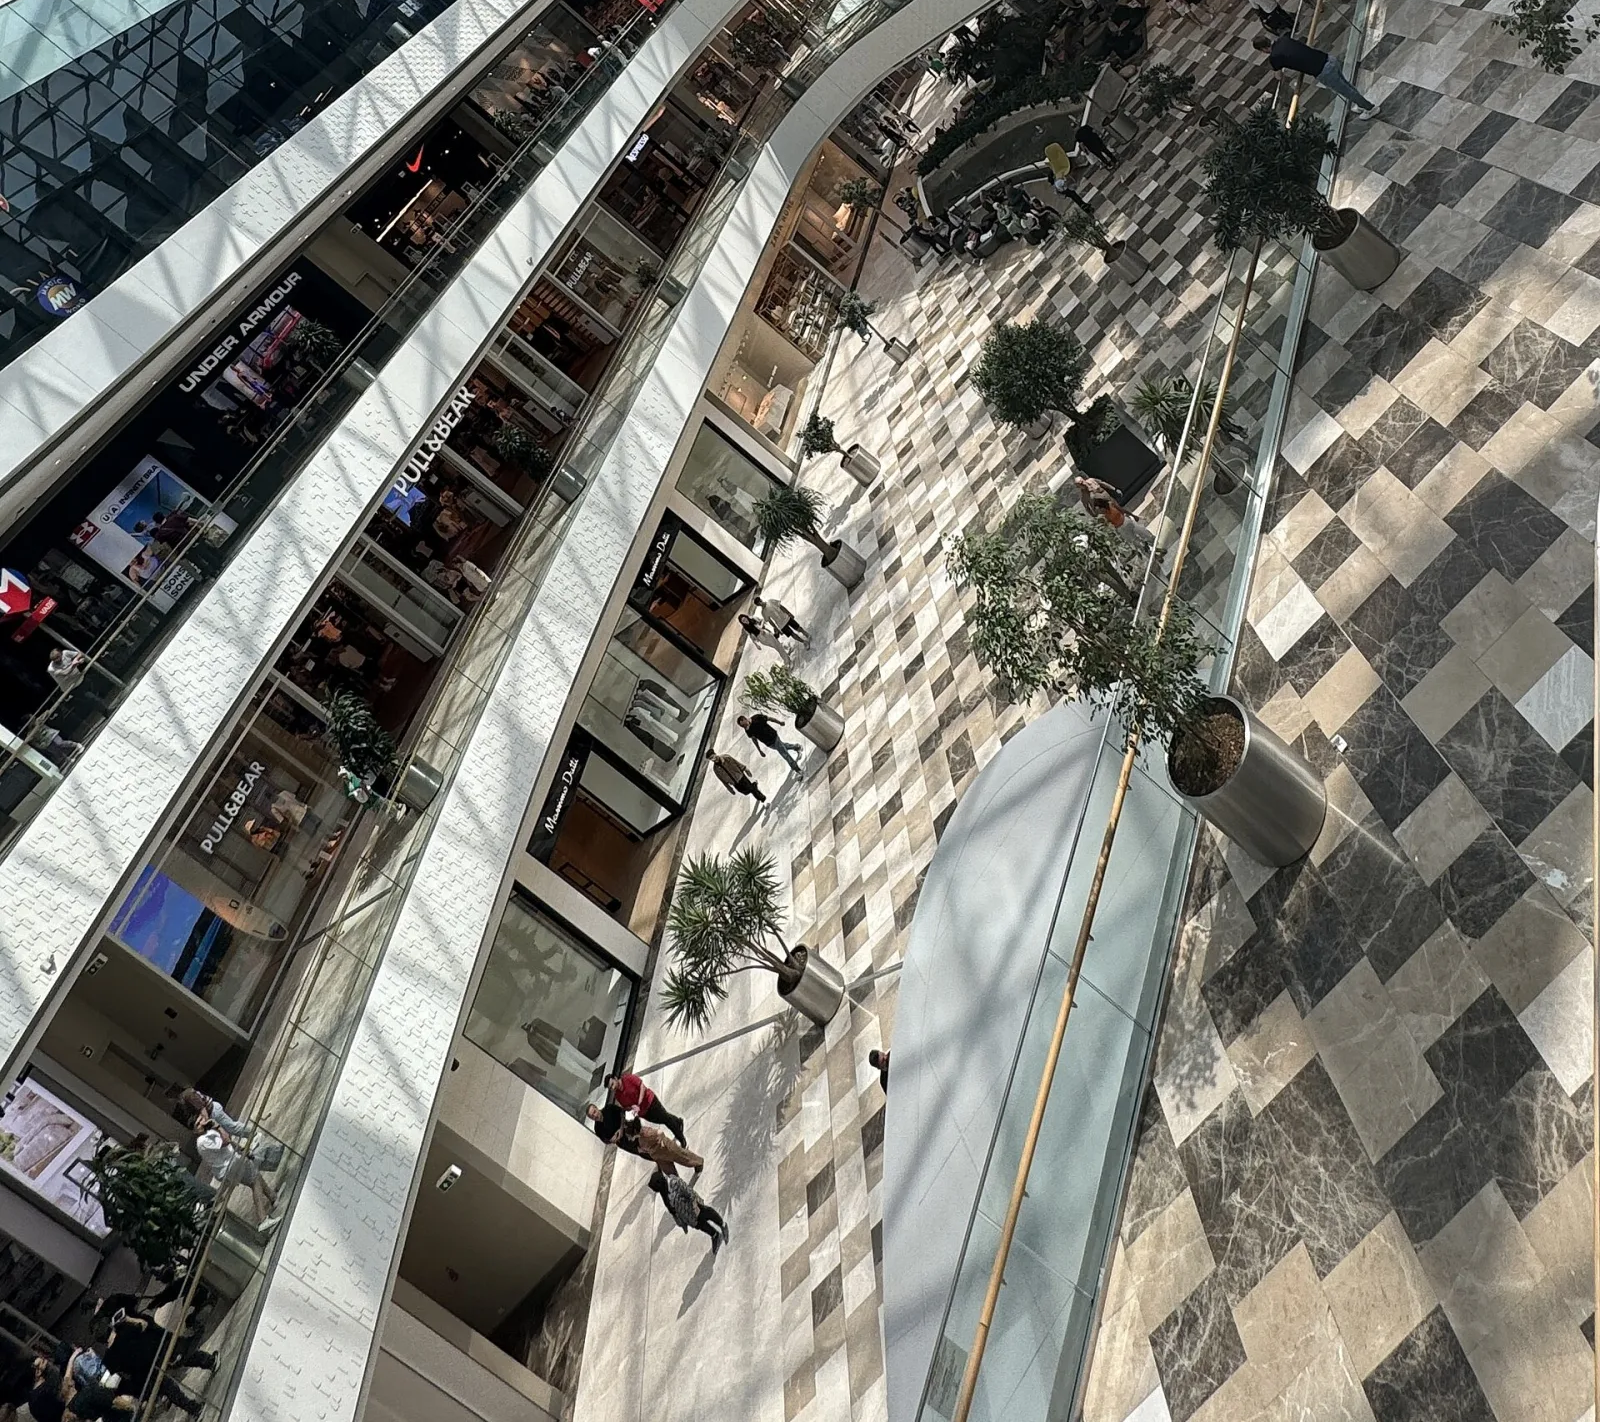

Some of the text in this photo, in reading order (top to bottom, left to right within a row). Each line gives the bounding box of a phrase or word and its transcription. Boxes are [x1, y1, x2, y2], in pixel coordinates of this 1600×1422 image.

[625, 133, 650, 162] NESPRESSO
[49, 283, 77, 311] MW
[566, 251, 594, 290] PULL&BEAR
[178, 271, 302, 393] UNDER ARMOUR
[394, 384, 477, 497] PULL&BEAR
[119, 478, 146, 505] INFINITY
[143, 464, 158, 483] BRA
[200, 761, 266, 855] PULL&BEAR
[544, 757, 579, 834] Massimo Dutti
